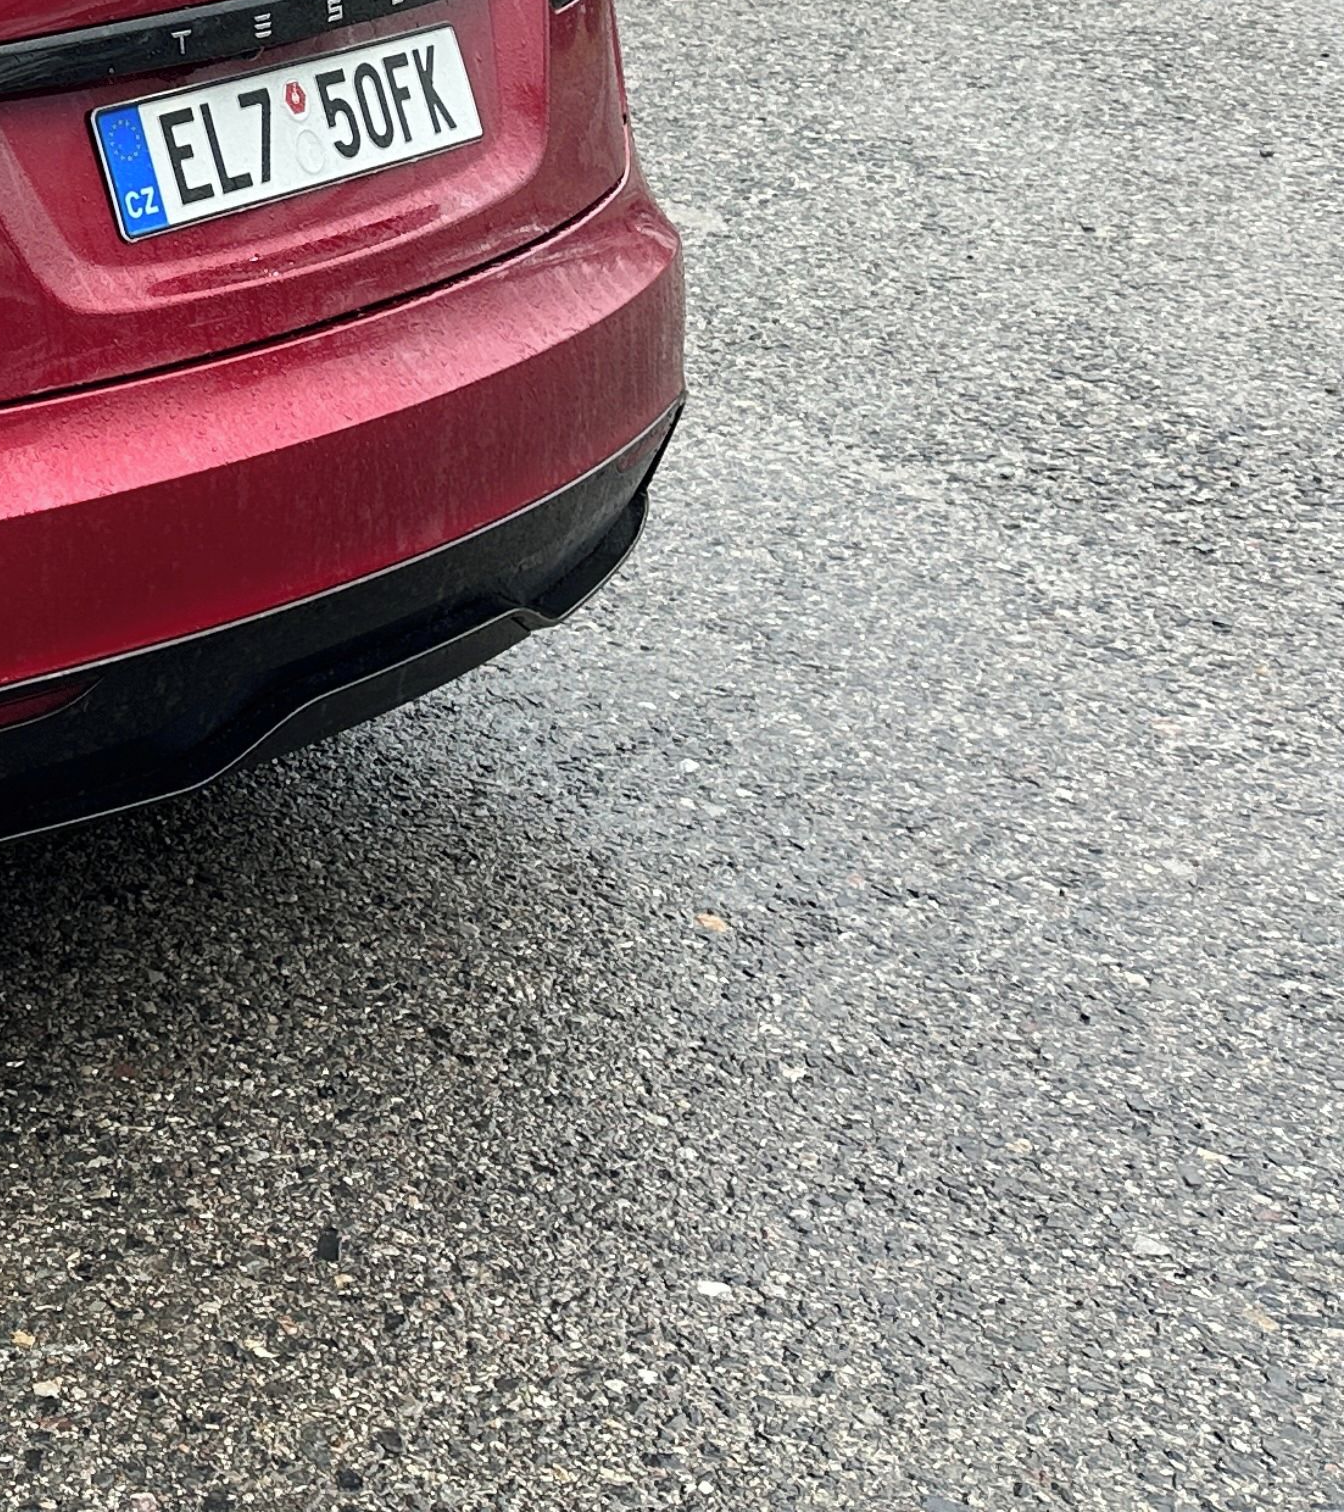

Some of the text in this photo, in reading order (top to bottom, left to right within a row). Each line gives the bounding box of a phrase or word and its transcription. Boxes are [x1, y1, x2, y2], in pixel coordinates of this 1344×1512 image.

[158, 44, 458, 206] EL7 50FK
[124, 186, 160, 220] CZ
